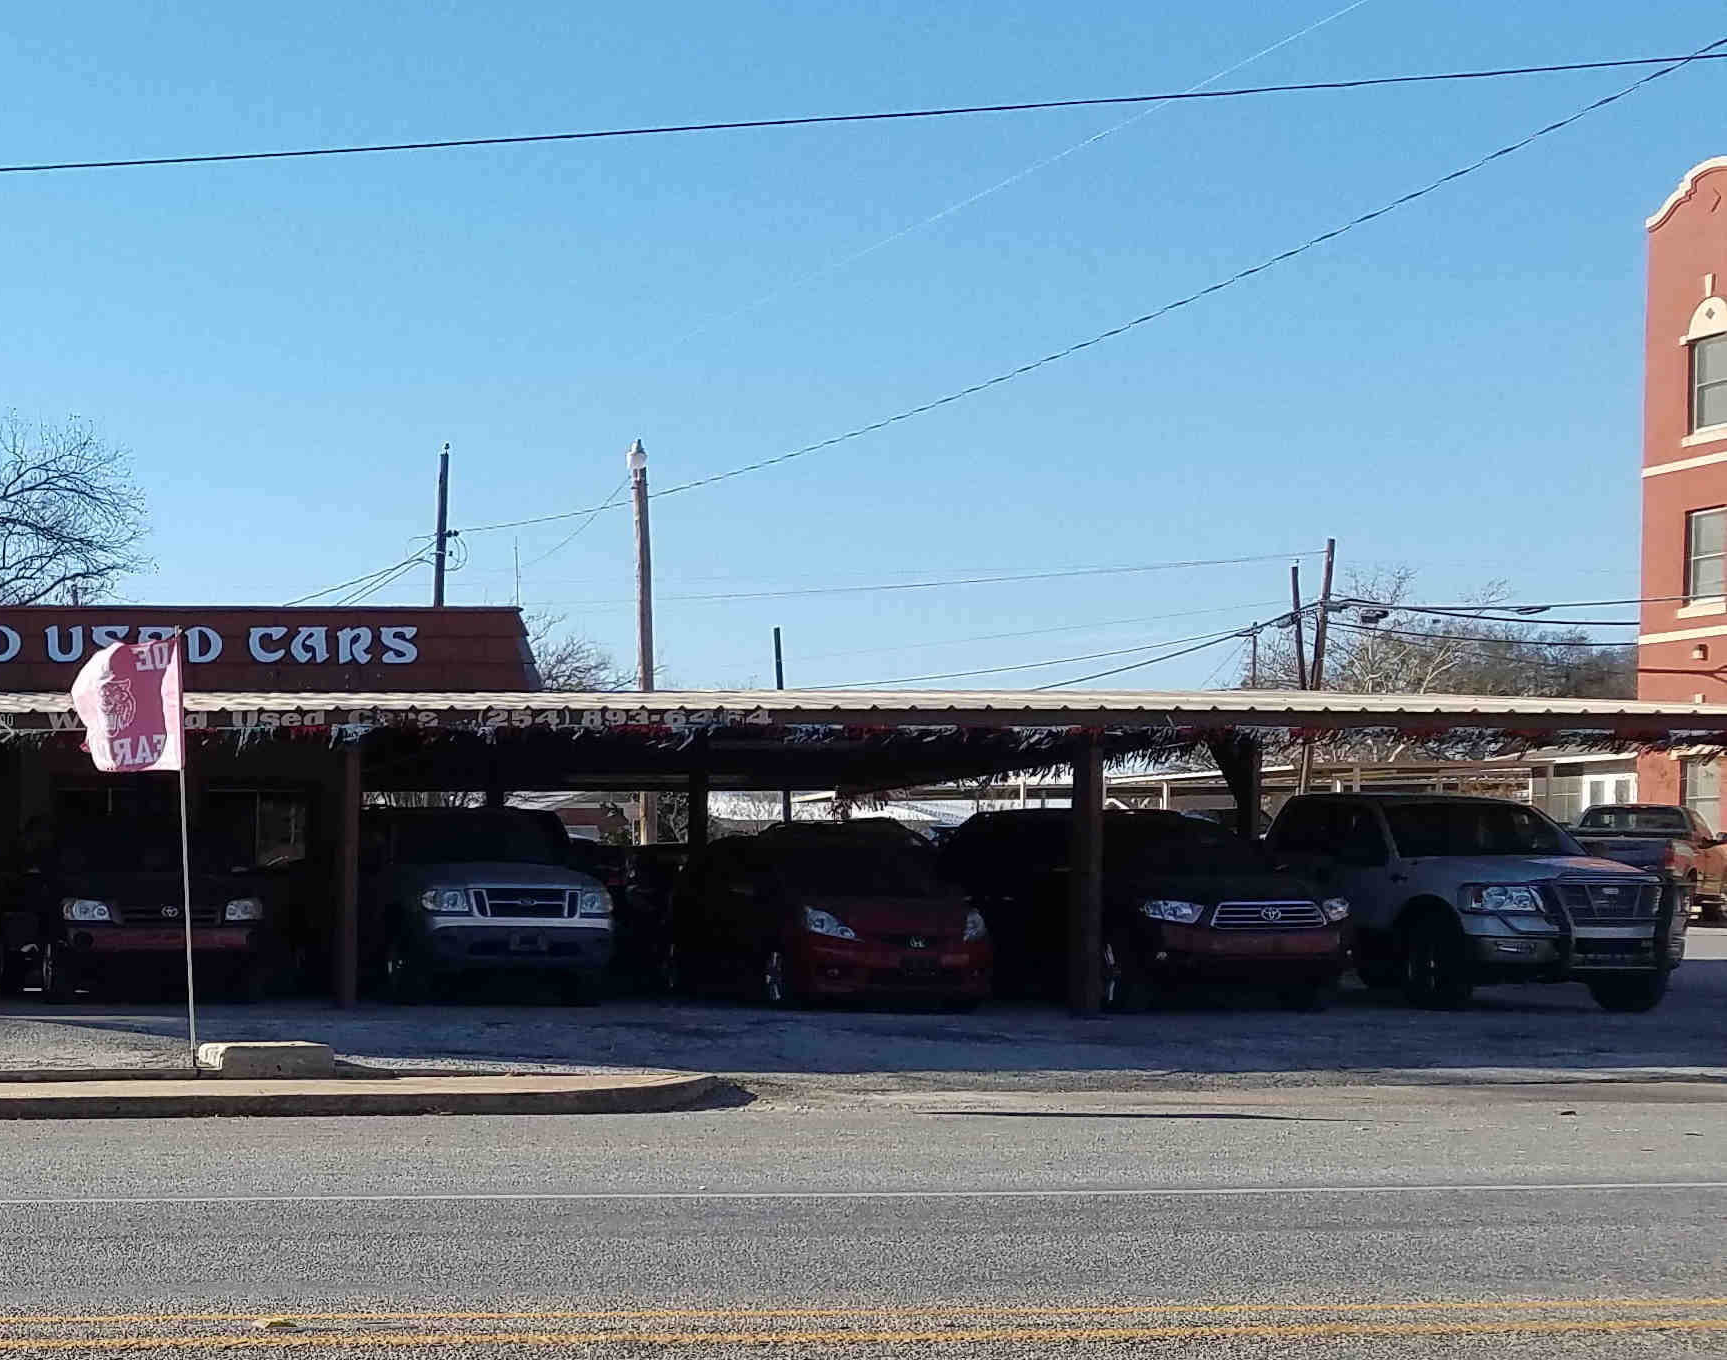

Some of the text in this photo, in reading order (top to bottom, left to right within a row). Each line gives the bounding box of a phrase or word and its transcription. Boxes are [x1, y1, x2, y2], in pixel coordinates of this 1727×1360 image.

[248, 625, 419, 664] CARS
[232, 711, 323, 728] Used
[477, 709, 570, 728] (254)
